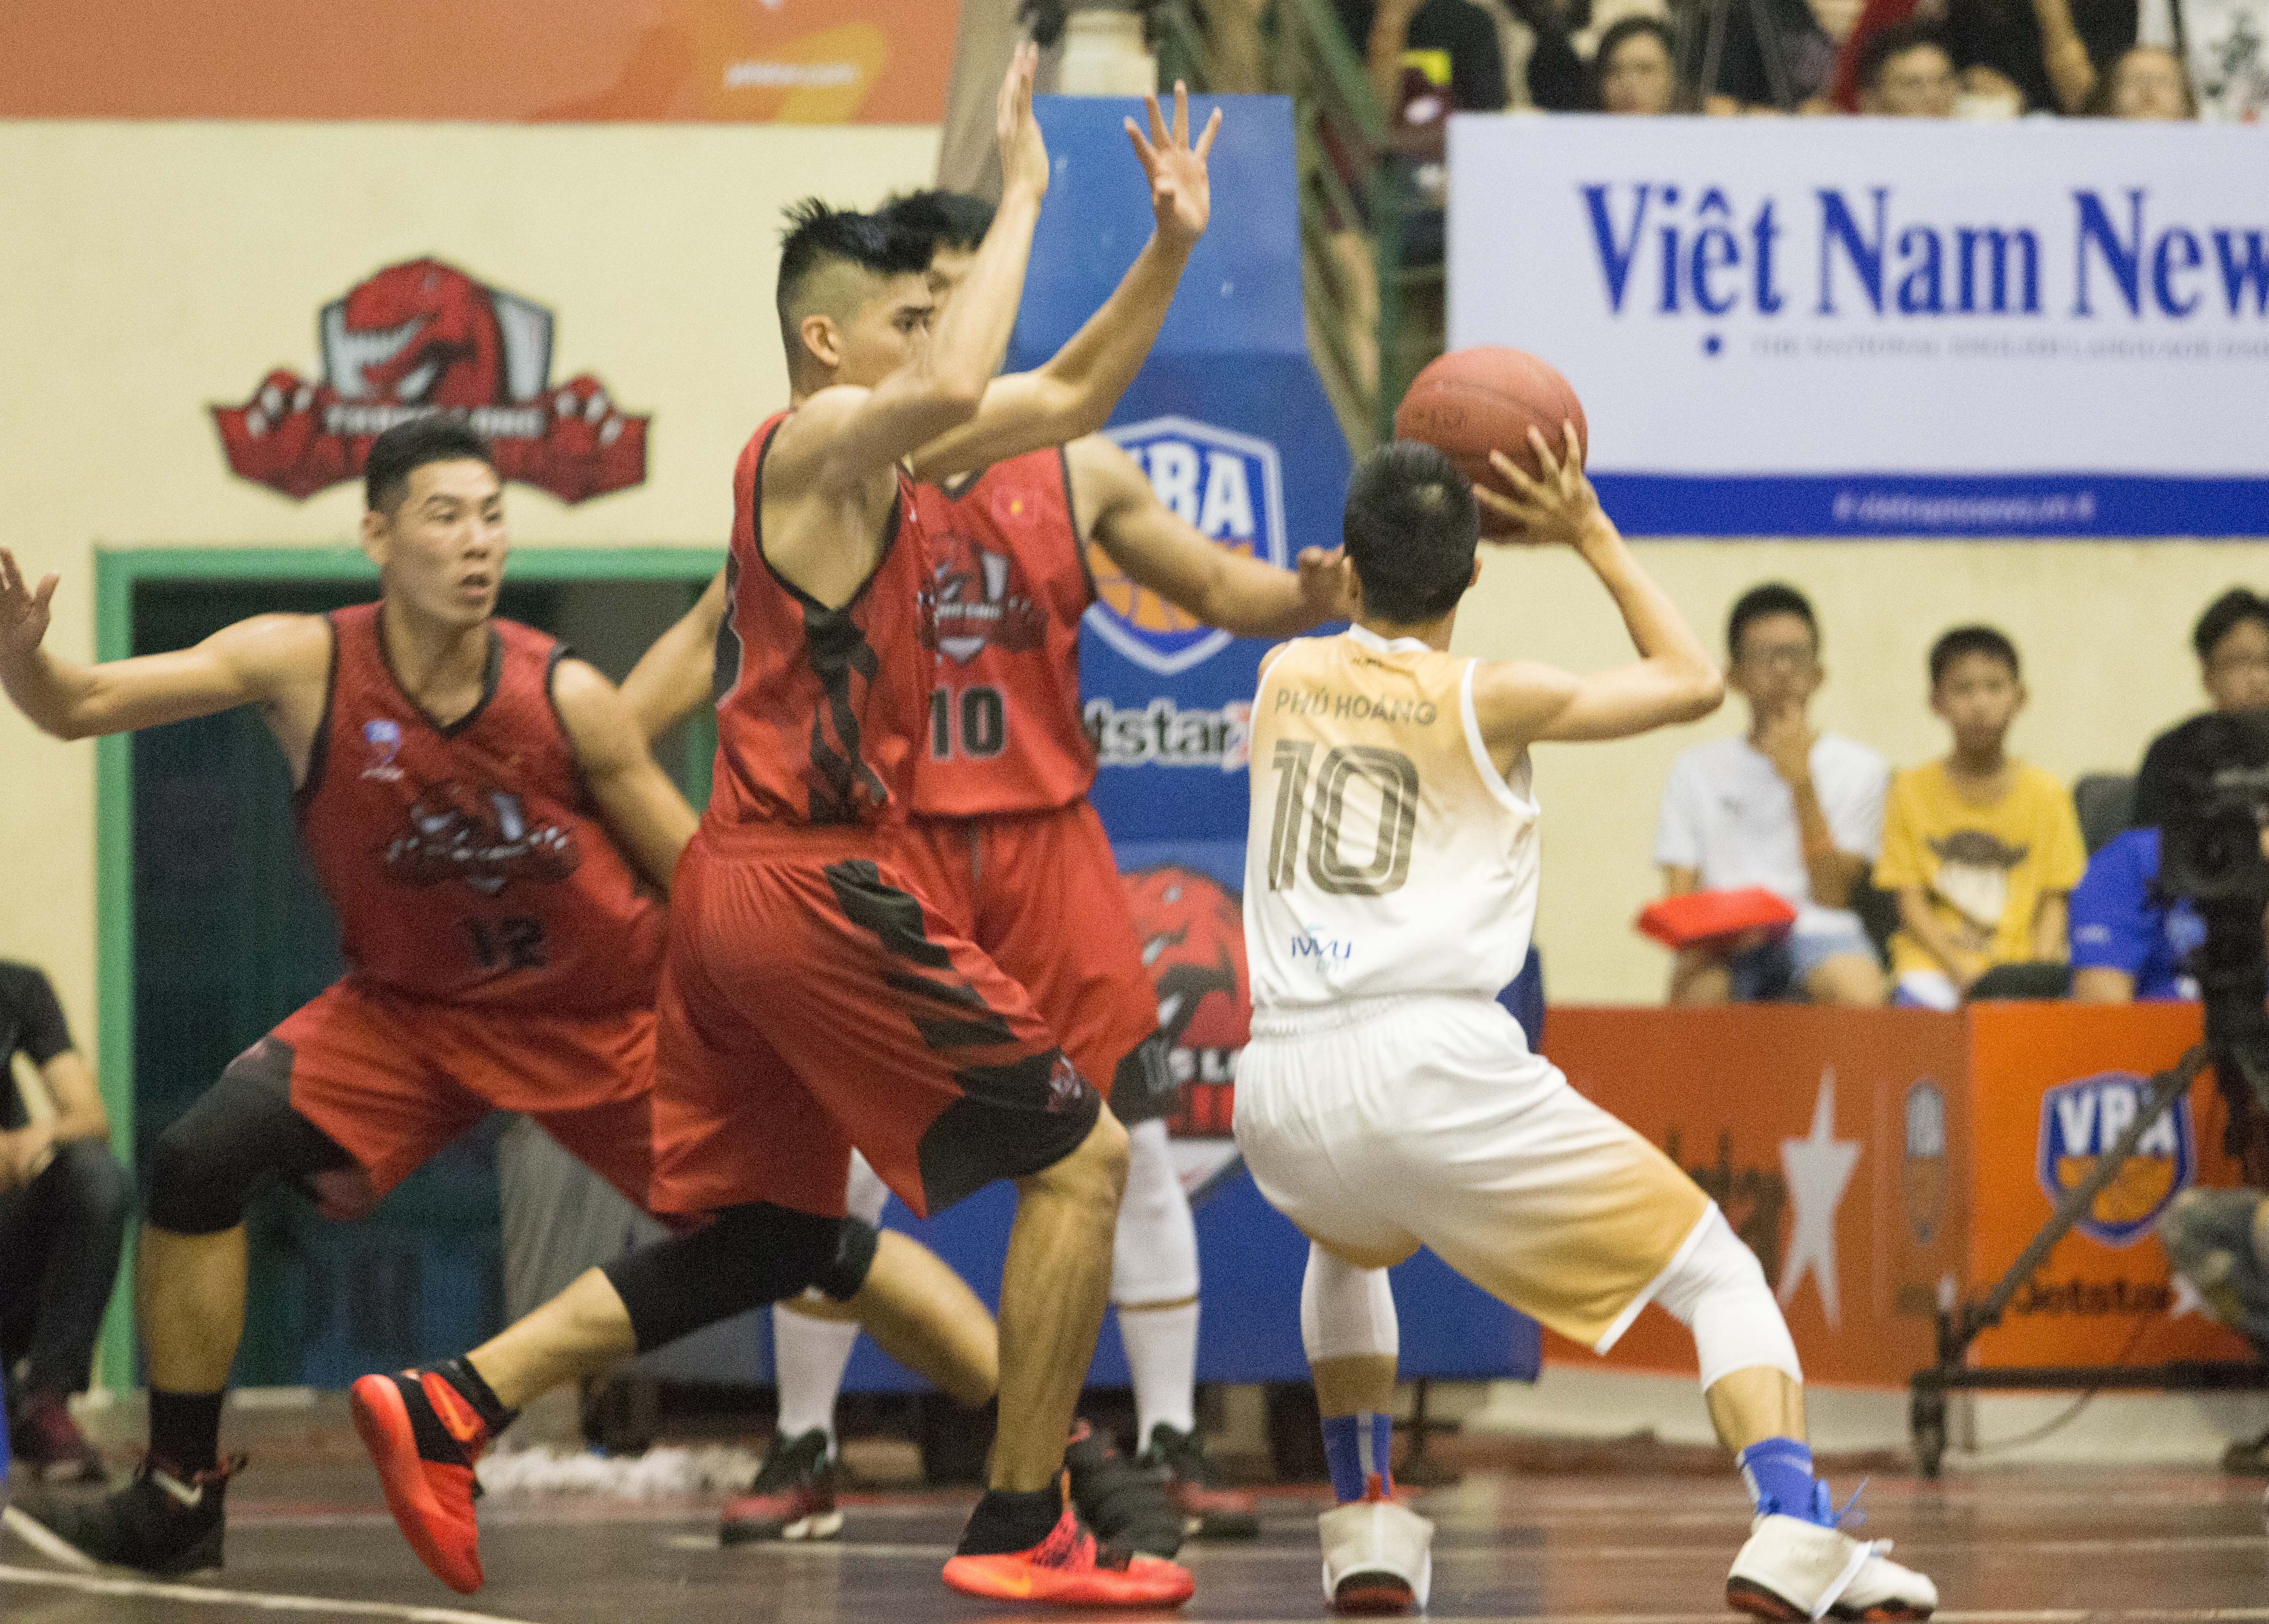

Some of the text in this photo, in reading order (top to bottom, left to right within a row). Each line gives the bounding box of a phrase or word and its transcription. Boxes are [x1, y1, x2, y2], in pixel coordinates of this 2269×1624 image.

[1577, 181, 1784, 358] Việt
[1813, 184, 2043, 317] Nam
[1131, 439, 1256, 538] BA
[929, 685, 1004, 760] 10
[1268, 739, 1419, 897] 10
